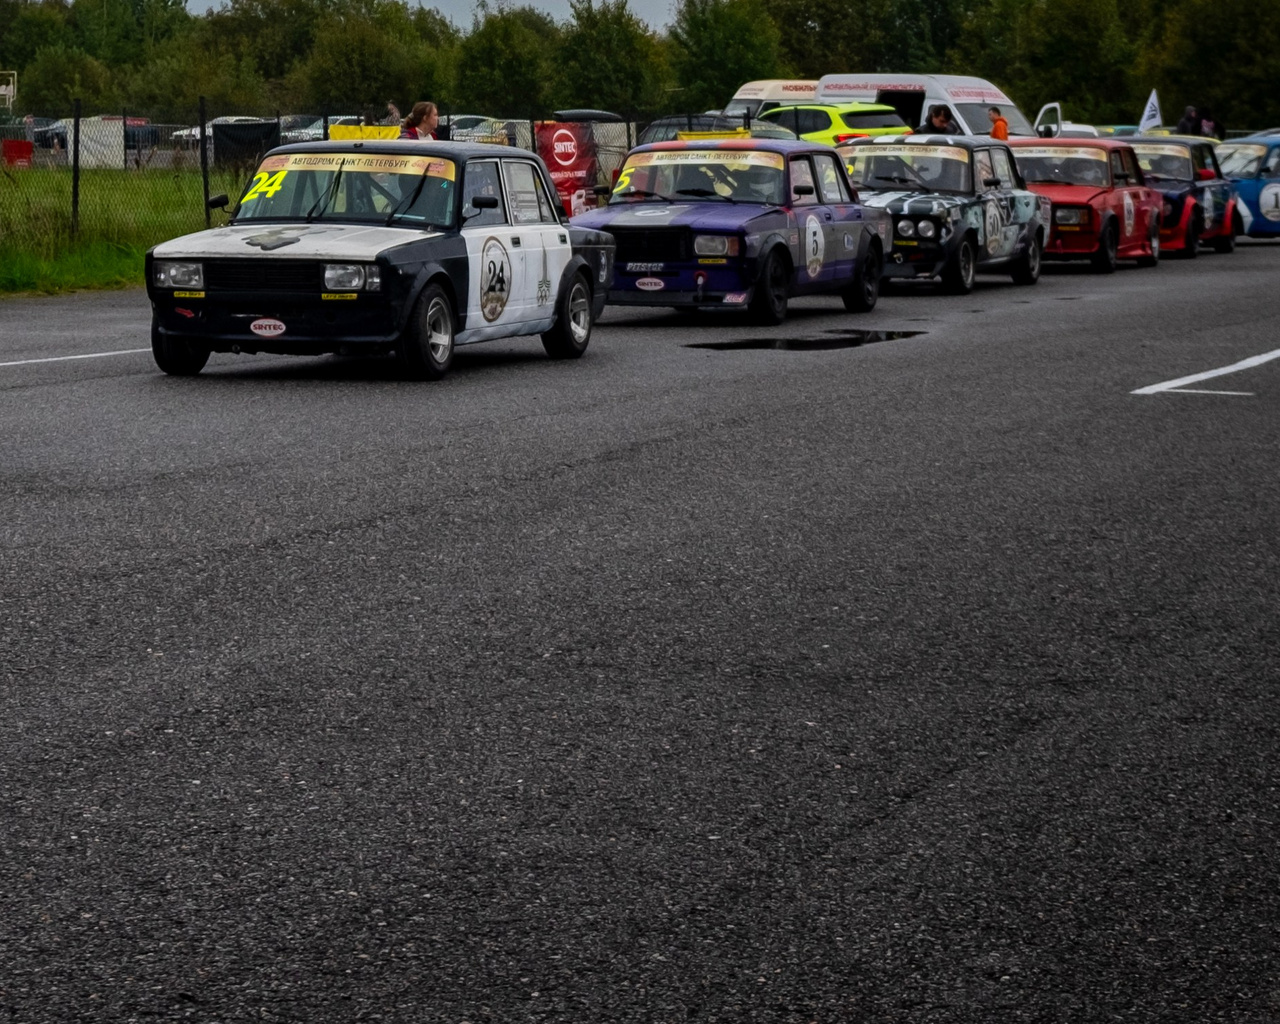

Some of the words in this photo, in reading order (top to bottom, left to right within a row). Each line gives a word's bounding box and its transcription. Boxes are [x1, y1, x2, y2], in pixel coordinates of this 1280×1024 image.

[554, 141, 575, 154] SINTEC
[291, 157, 334, 166] АВТОДРОМ
[240, 170, 288, 204] 24
[612, 167, 635, 193] 5
[812, 230, 818, 256] 5
[485, 260, 506, 293] 24
[252, 323, 284, 331] SINTEC
